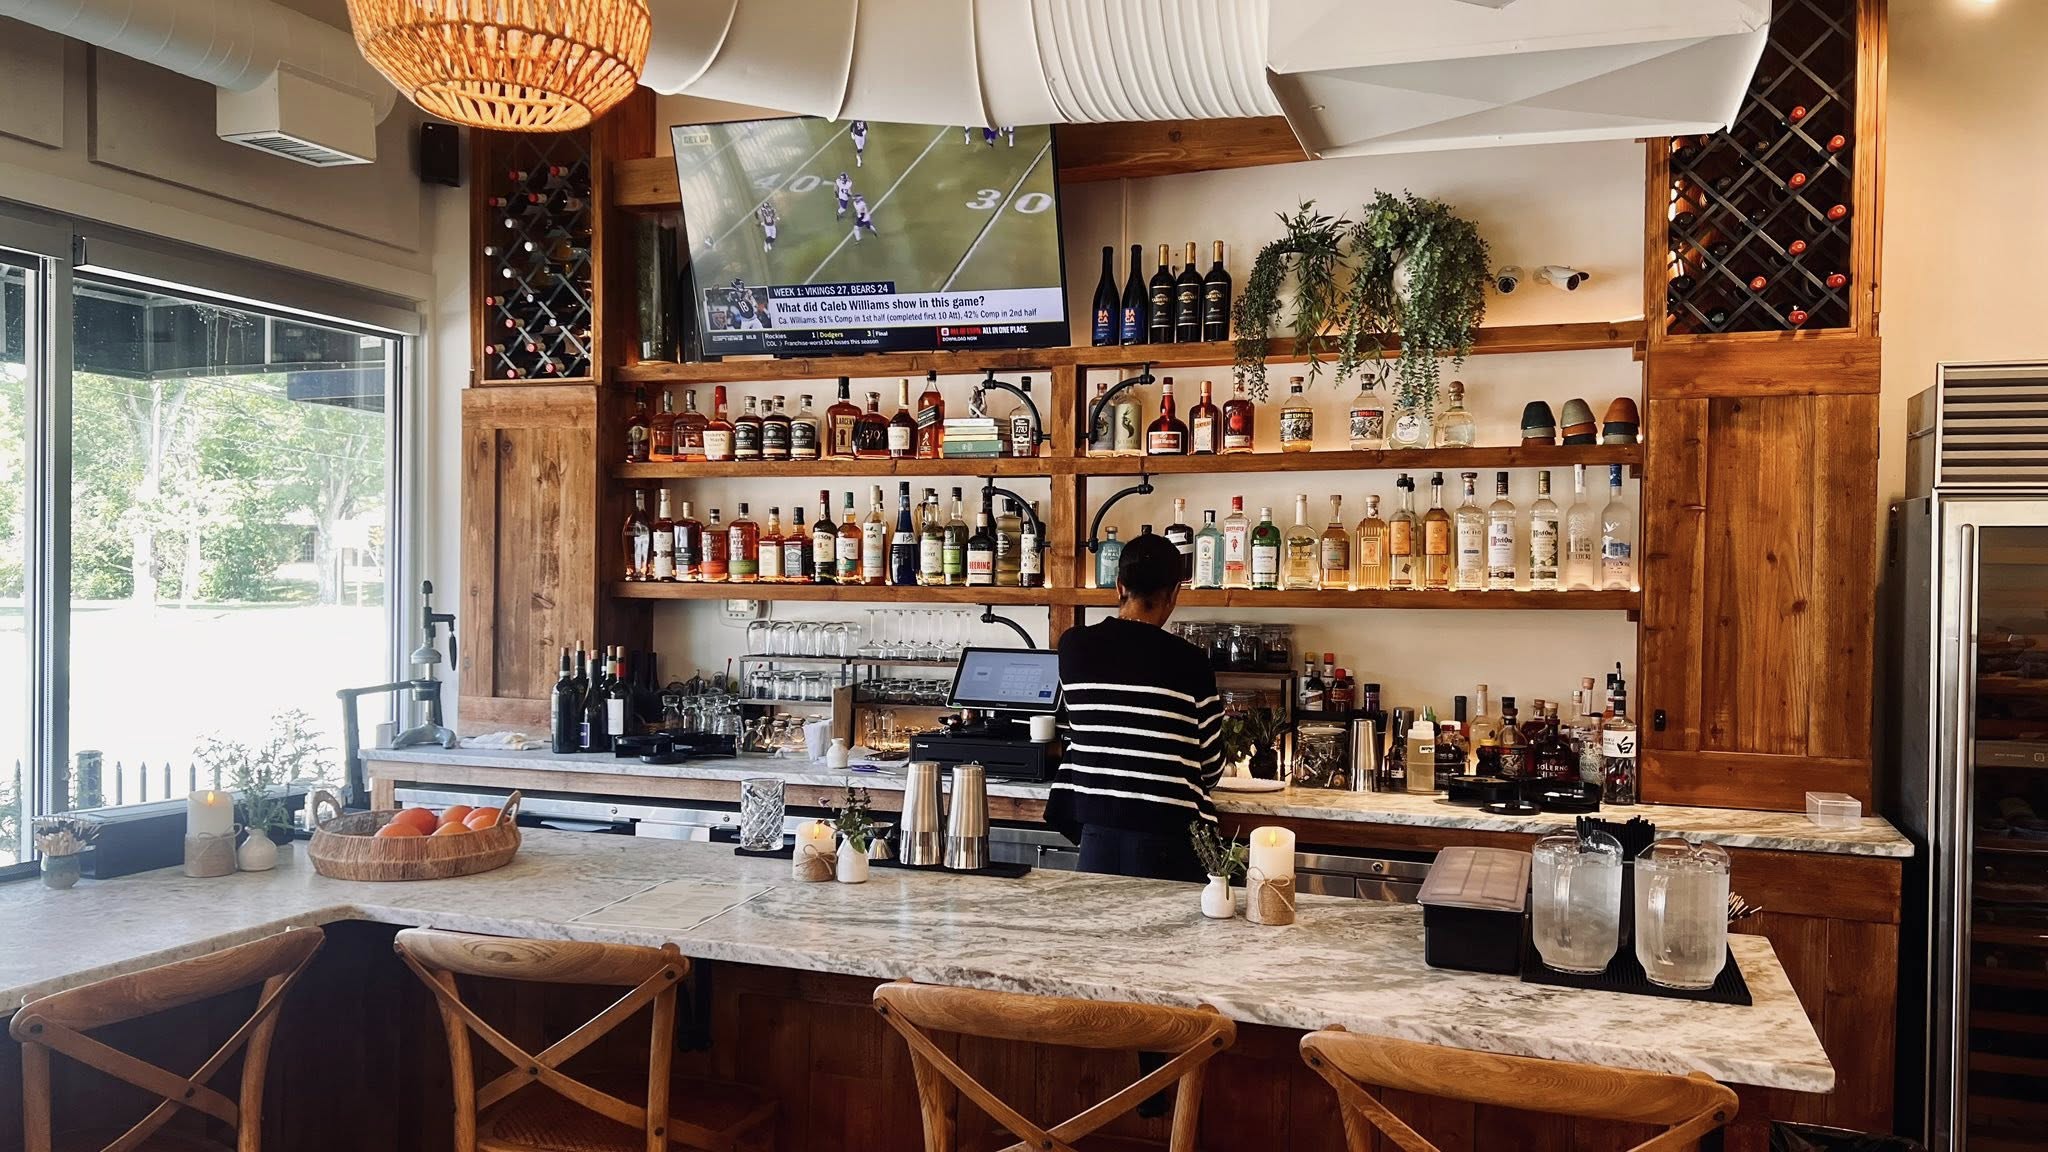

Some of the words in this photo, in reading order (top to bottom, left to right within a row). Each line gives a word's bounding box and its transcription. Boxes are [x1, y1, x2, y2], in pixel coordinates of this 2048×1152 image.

[773, 287, 795, 297] WEEK
[797, 287, 804, 296] 1:
[805, 286, 836, 296] VIKINGS
[837, 286, 850, 296] 27,
[851, 284, 876, 294] BEARS
[877, 284, 888, 293] 24
[776, 302, 801, 313] What
[803, 302, 818, 312] did
[820, 301, 847, 312] Caleb
[848, 299, 890, 311] Williams
[892, 299, 917, 309] show
[919, 298, 929, 308] in
[931, 297, 949, 307] this
[952, 295, 985, 309] game?
[778, 316, 788, 325] Ca.
[789, 315, 818, 324] Williams:
[818, 315, 833, 324] 81%
[834, 314, 853, 324] Comp
[854, 314, 861, 322] in
[863, 314, 872, 322] 1st
[873, 313, 886, 322] half
[886, 312, 922, 323] (completed
[924, 312, 937, 320] first
[938, 311, 947, 320] 10
[948, 311, 963, 320] Att),
[964, 310, 979, 319] 42%
[980, 309, 1000, 319] Comp
[1001, 309, 1008, 317] in
[1009, 308, 1023, 317] 2nd
[1024, 307, 1037, 317] half
[820, 331, 844, 339] Dodgers
[982, 327, 992, 335] ALL
[999, 326, 1011, 334] ONE
[1011, 325, 1029, 334] PLACE.
[1616, 735, 1634, 754] 白
